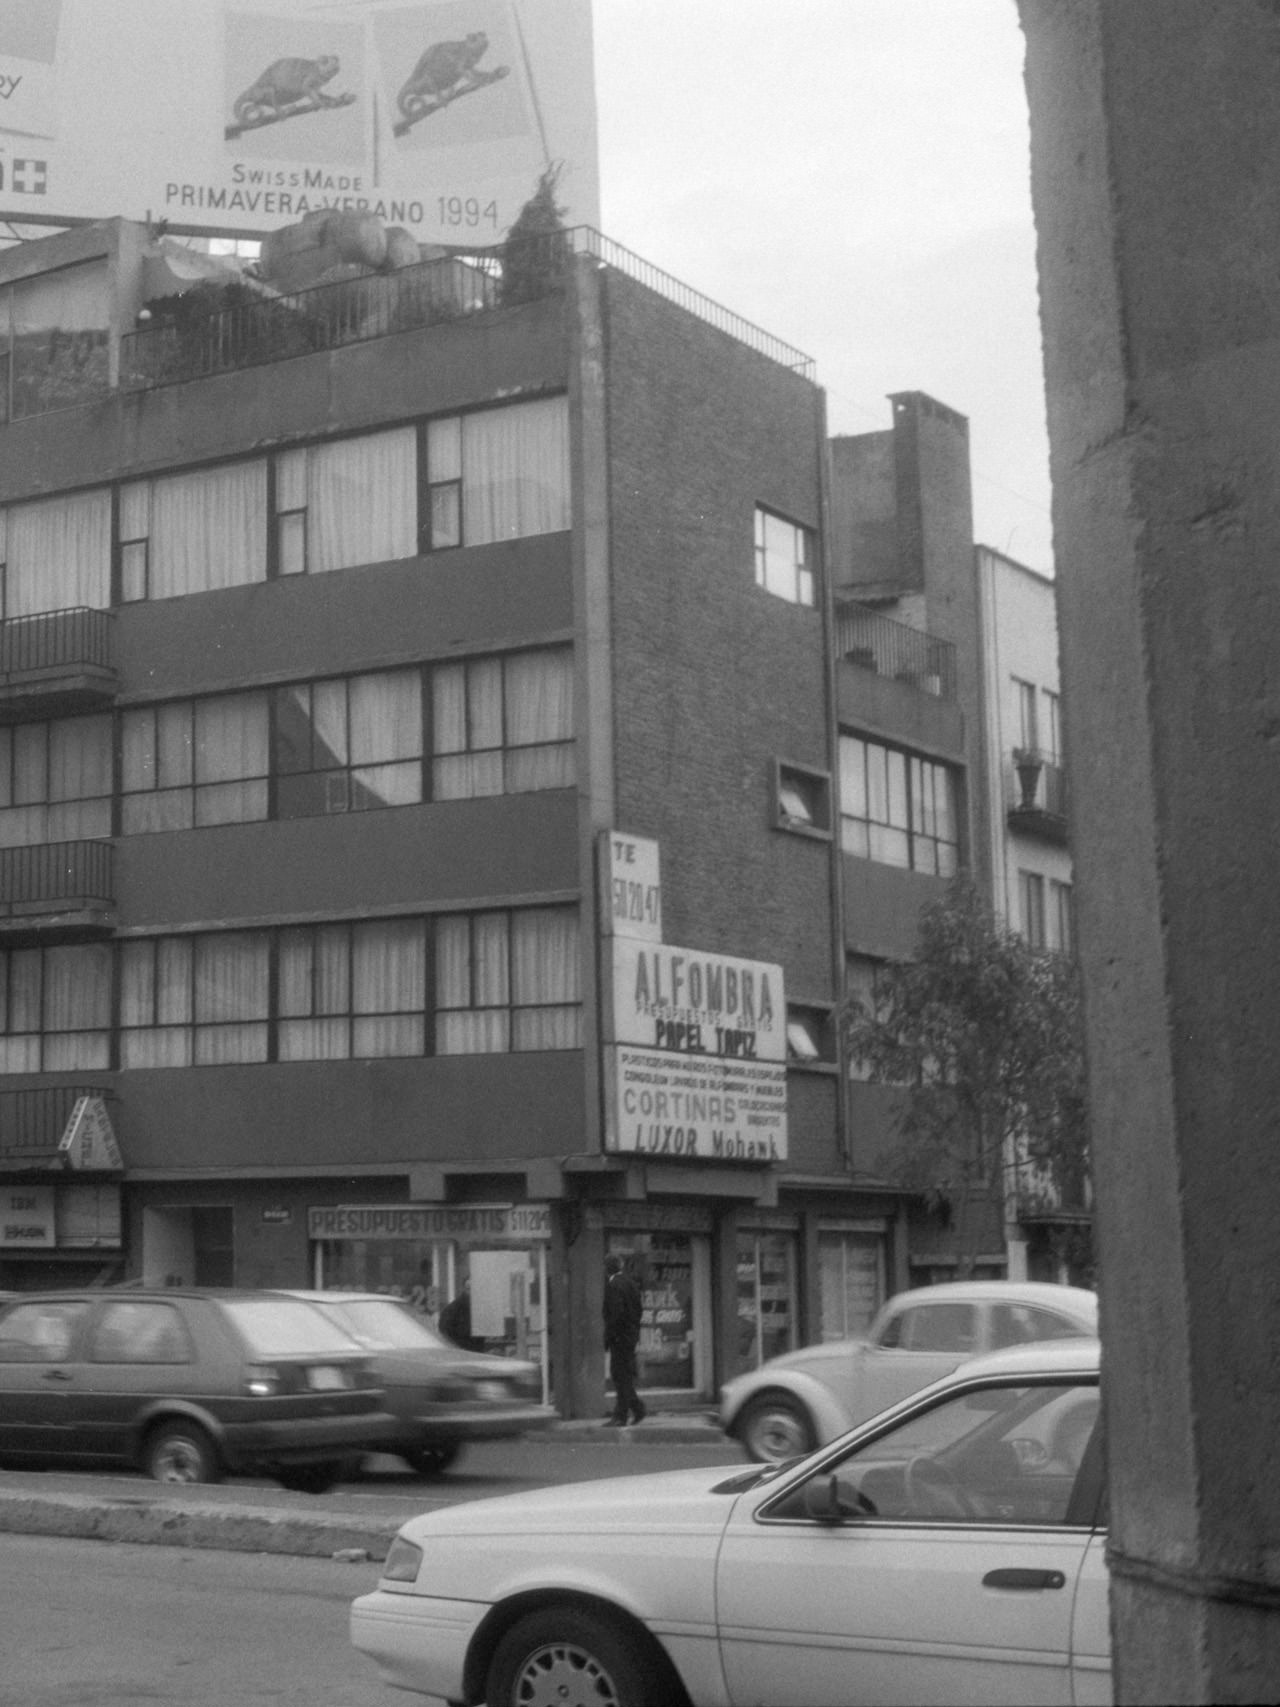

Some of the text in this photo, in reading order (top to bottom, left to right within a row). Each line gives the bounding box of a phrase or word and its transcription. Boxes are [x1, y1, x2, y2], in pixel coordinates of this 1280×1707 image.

[437, 195, 498, 229] 1994
[634, 950, 773, 1023] ALFOMBRA
[655, 1019, 757, 1058] PAPEL TAPIZ
[623, 1088, 737, 1123] CORTINAS
[635, 1123, 698, 1155] LUXOR
